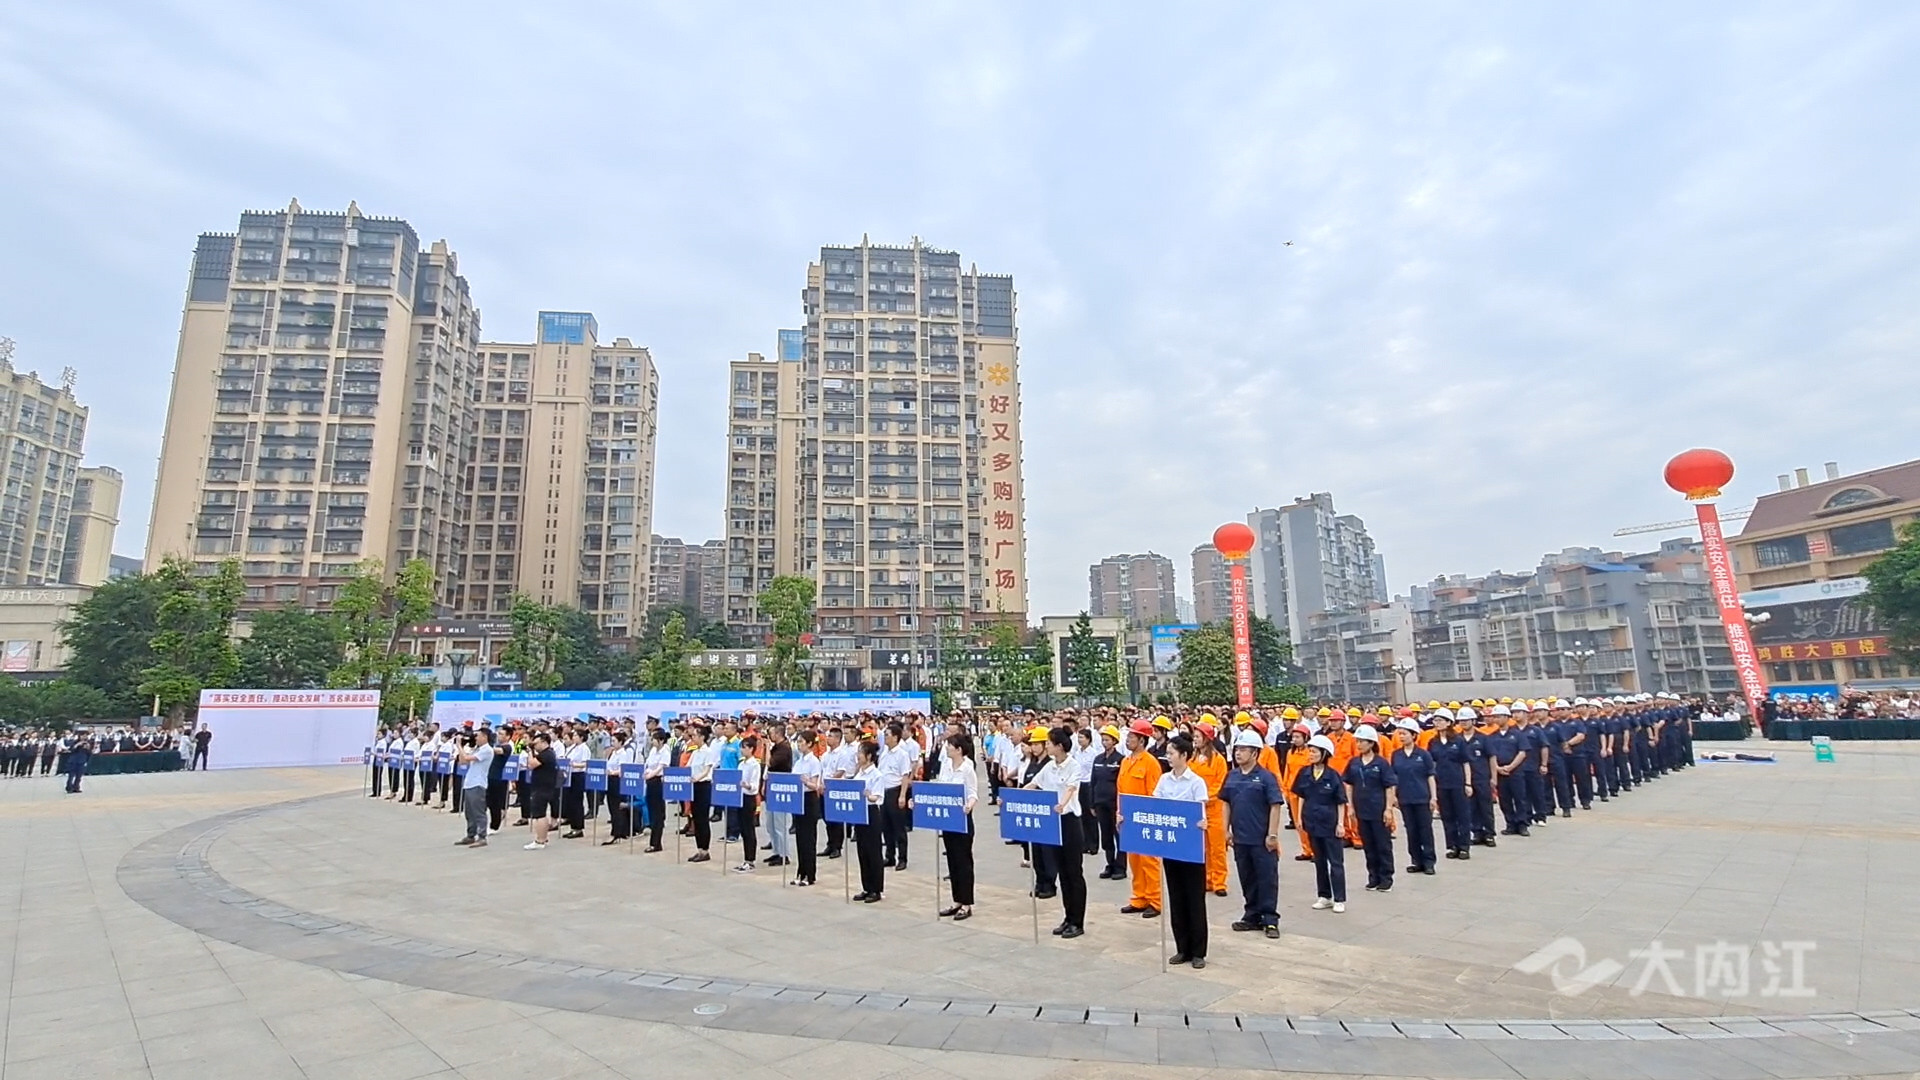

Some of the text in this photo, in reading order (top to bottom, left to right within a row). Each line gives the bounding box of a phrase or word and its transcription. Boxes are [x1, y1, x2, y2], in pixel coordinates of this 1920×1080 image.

[989, 394, 1016, 590] 好又多购物广场
[1233, 578, 1248, 645] 内江市2021年
[1702, 522, 1765, 704] 落实安全责任 推动安全发
[1757, 639, 1876, 662] 鸿胜大酒楼
[1015, 815, 1042, 829] 代表队
[1132, 811, 1187, 829] 威远县港华燃气
[1141, 827, 1177, 843] 代表队
